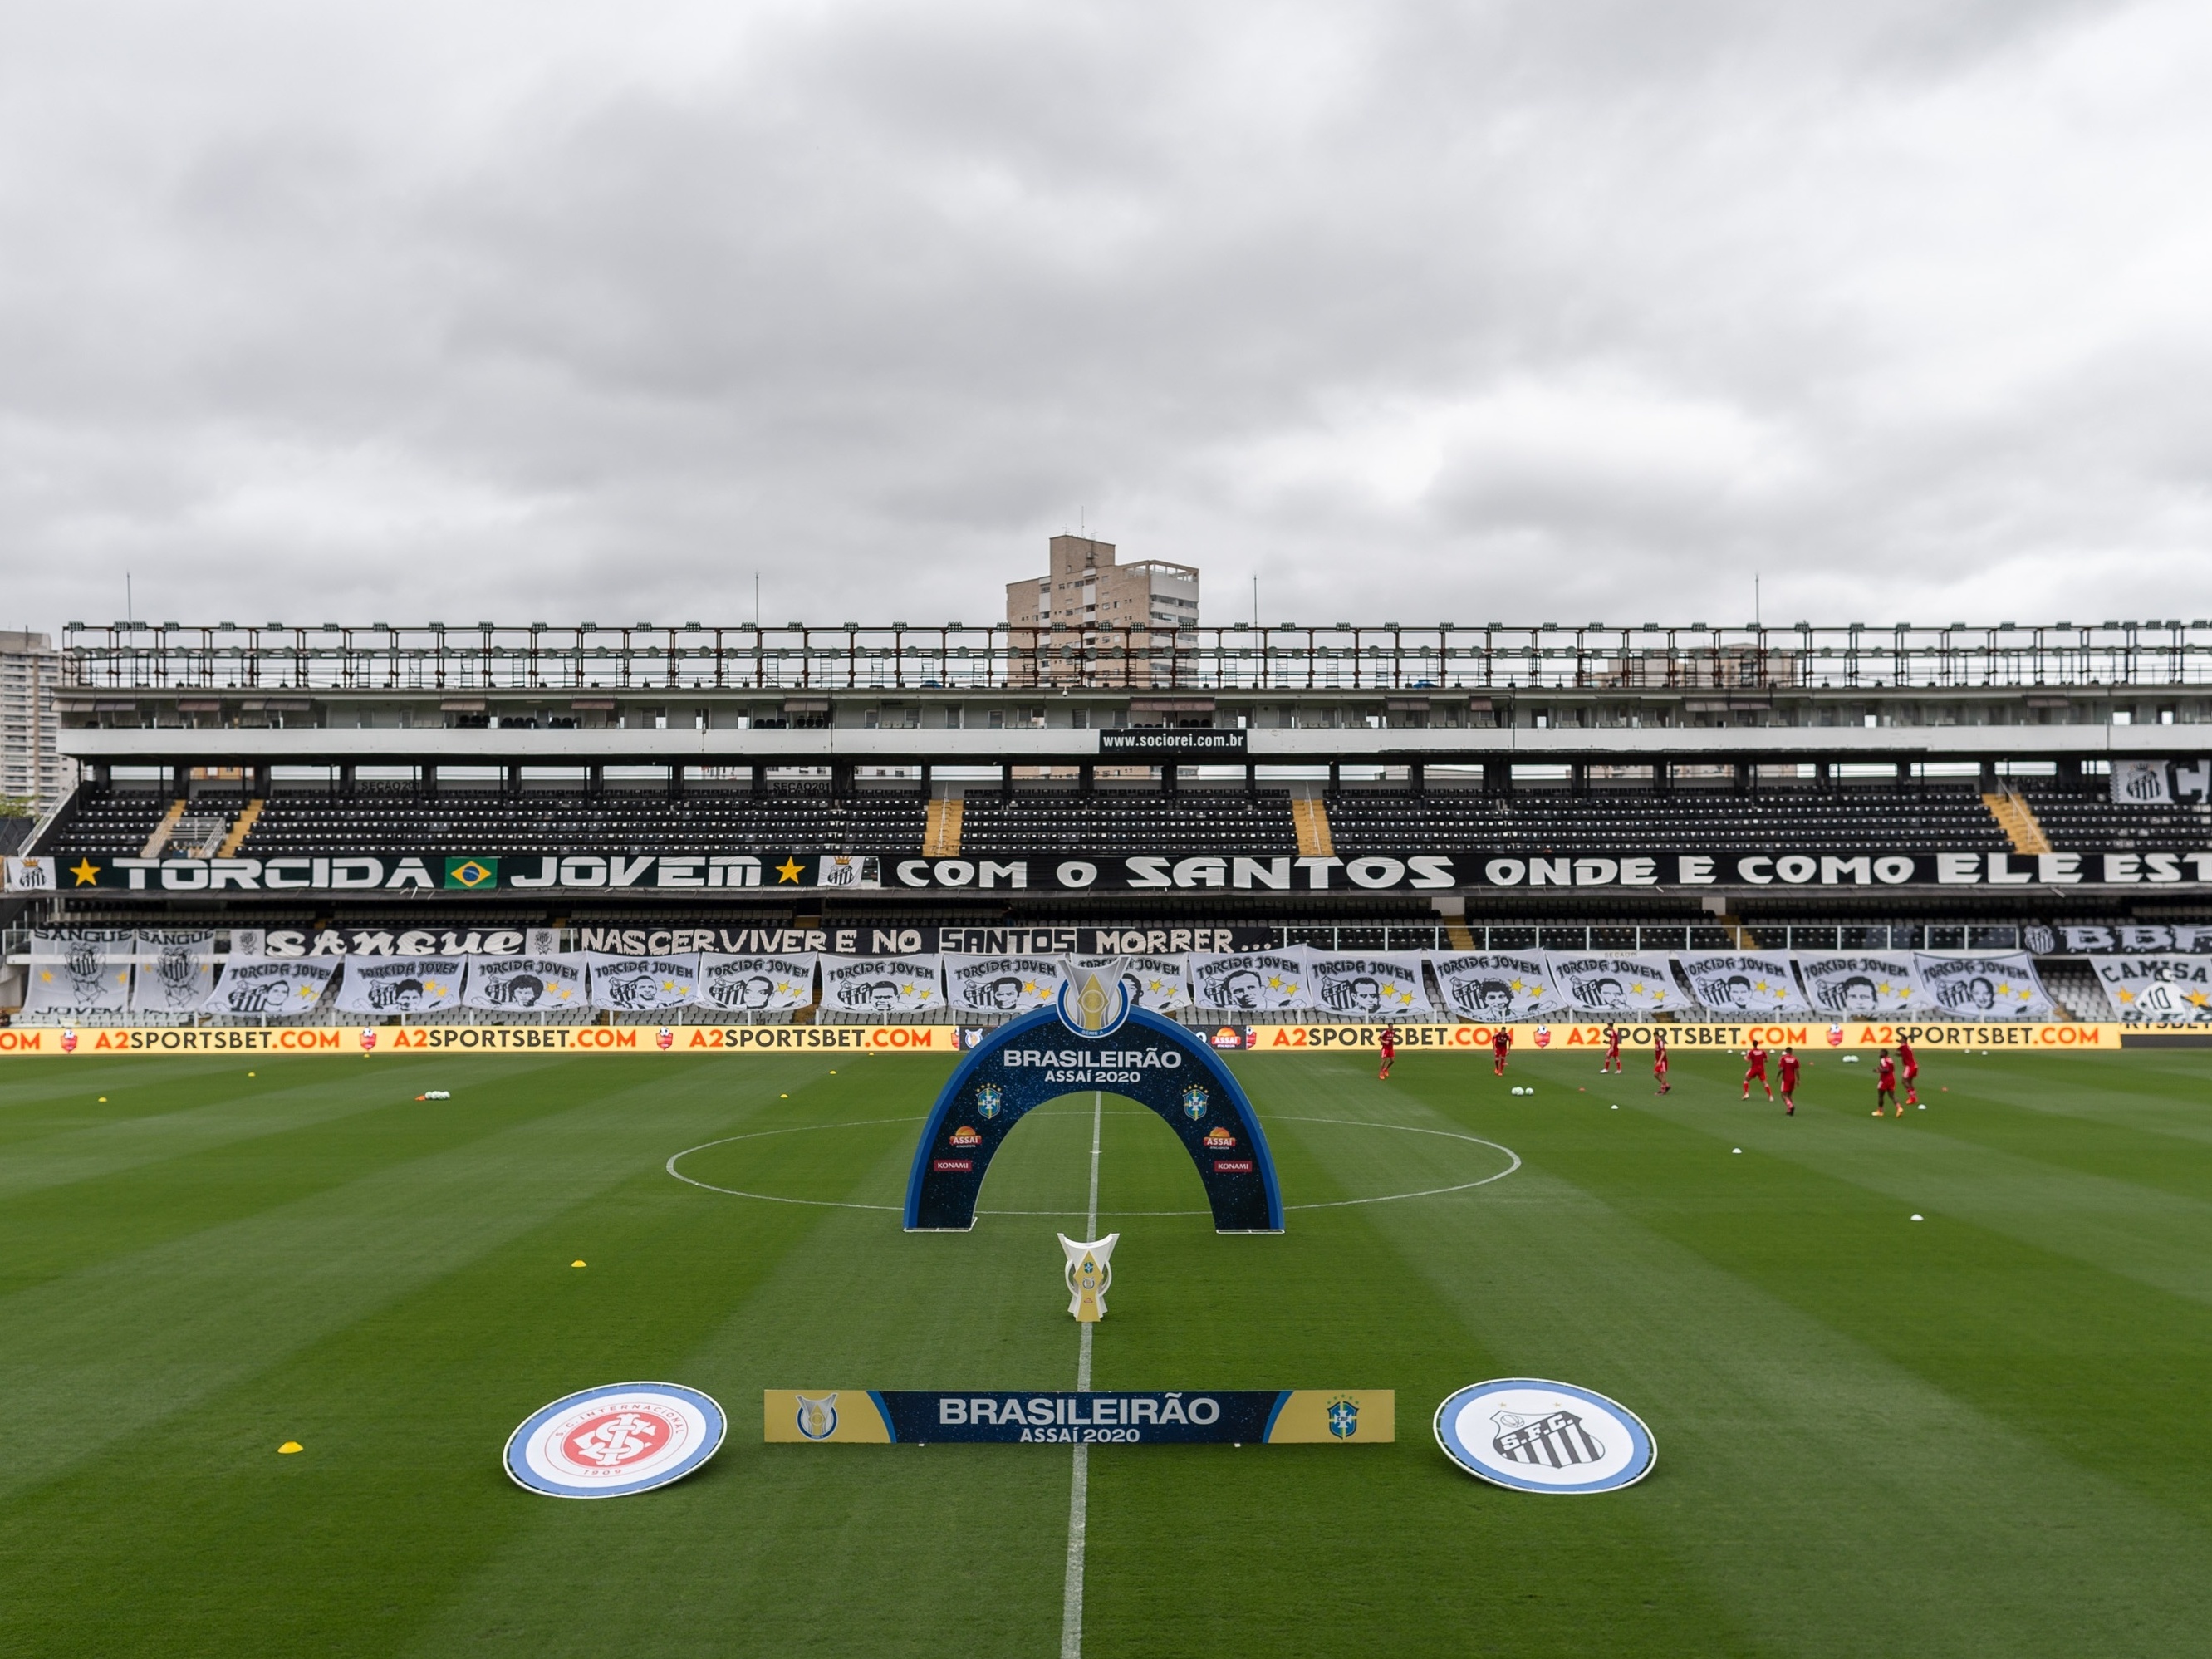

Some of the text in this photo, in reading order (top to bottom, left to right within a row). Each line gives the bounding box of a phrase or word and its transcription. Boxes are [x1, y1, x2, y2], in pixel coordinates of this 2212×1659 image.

[1103, 733, 1243, 747] www.sociorei.com.br
[112, 856, 762, 890] TORCIDA JOVEM
[896, 859, 1028, 888] COM
[1056, 861, 1098, 888] O
[1126, 856, 1455, 890] SANTOS
[1485, 857, 1658, 886] ONDE
[1678, 855, 1717, 885] E
[1737, 855, 1915, 885] COMO
[1936, 852, 2084, 883] ELE
[34, 928, 133, 943] SANGUE
[138, 929, 214, 945] SANGUE
[836, 929, 857, 953] E
[872, 929, 922, 954] NO
[941, 928, 1077, 954] SANTOS
[230, 963, 291, 980] TORCIDA
[478, 960, 580, 981] TORCIDA JOVEM
[595, 960, 694, 979] TORCIDA JOVEM
[706, 958, 810, 978] TORCIDA JOVEM
[828, 960, 935, 981] TORCIDA JOVEM
[954, 959, 1057, 979] TORCIDA JOVEM
[1135, 959, 1181, 976] JOVEM
[1196, 956, 1301, 979] TORCIDA JOVEM
[1311, 960, 1415, 984] TORCIDA JOVEM
[1437, 956, 1543, 976] TORCIDA JOVEM
[1556, 960, 1665, 981] TORCIDA JOVEM
[1739, 957, 1786, 977] JOVEM
[1860, 959, 1909, 977] JOVEM
[1980, 961, 2030, 979] JOVEM
[2148, 986, 2172, 1010] 10
[95, 1031, 340, 1049] A2SPORTSBET.COM
[393, 1029, 636, 1048] A2SPORTSBET.COM
[689, 1029, 931, 1048] A2SPORTSBET.COM
[1860, 1026, 2099, 1045] A2SPORTSBET.COM
[1003, 1048, 1182, 1068] BRASILEIRÃO
[1044, 1069, 1140, 1082] ASSAÍ 2020
[580, 1403, 685, 1435] INTERNACIONAL
[939, 1392, 1220, 1426] BRASILEIRÃO
[1020, 1426, 1140, 1443] ASSAÍ 2020
[1500, 1414, 1573, 1451] S.F.C.
